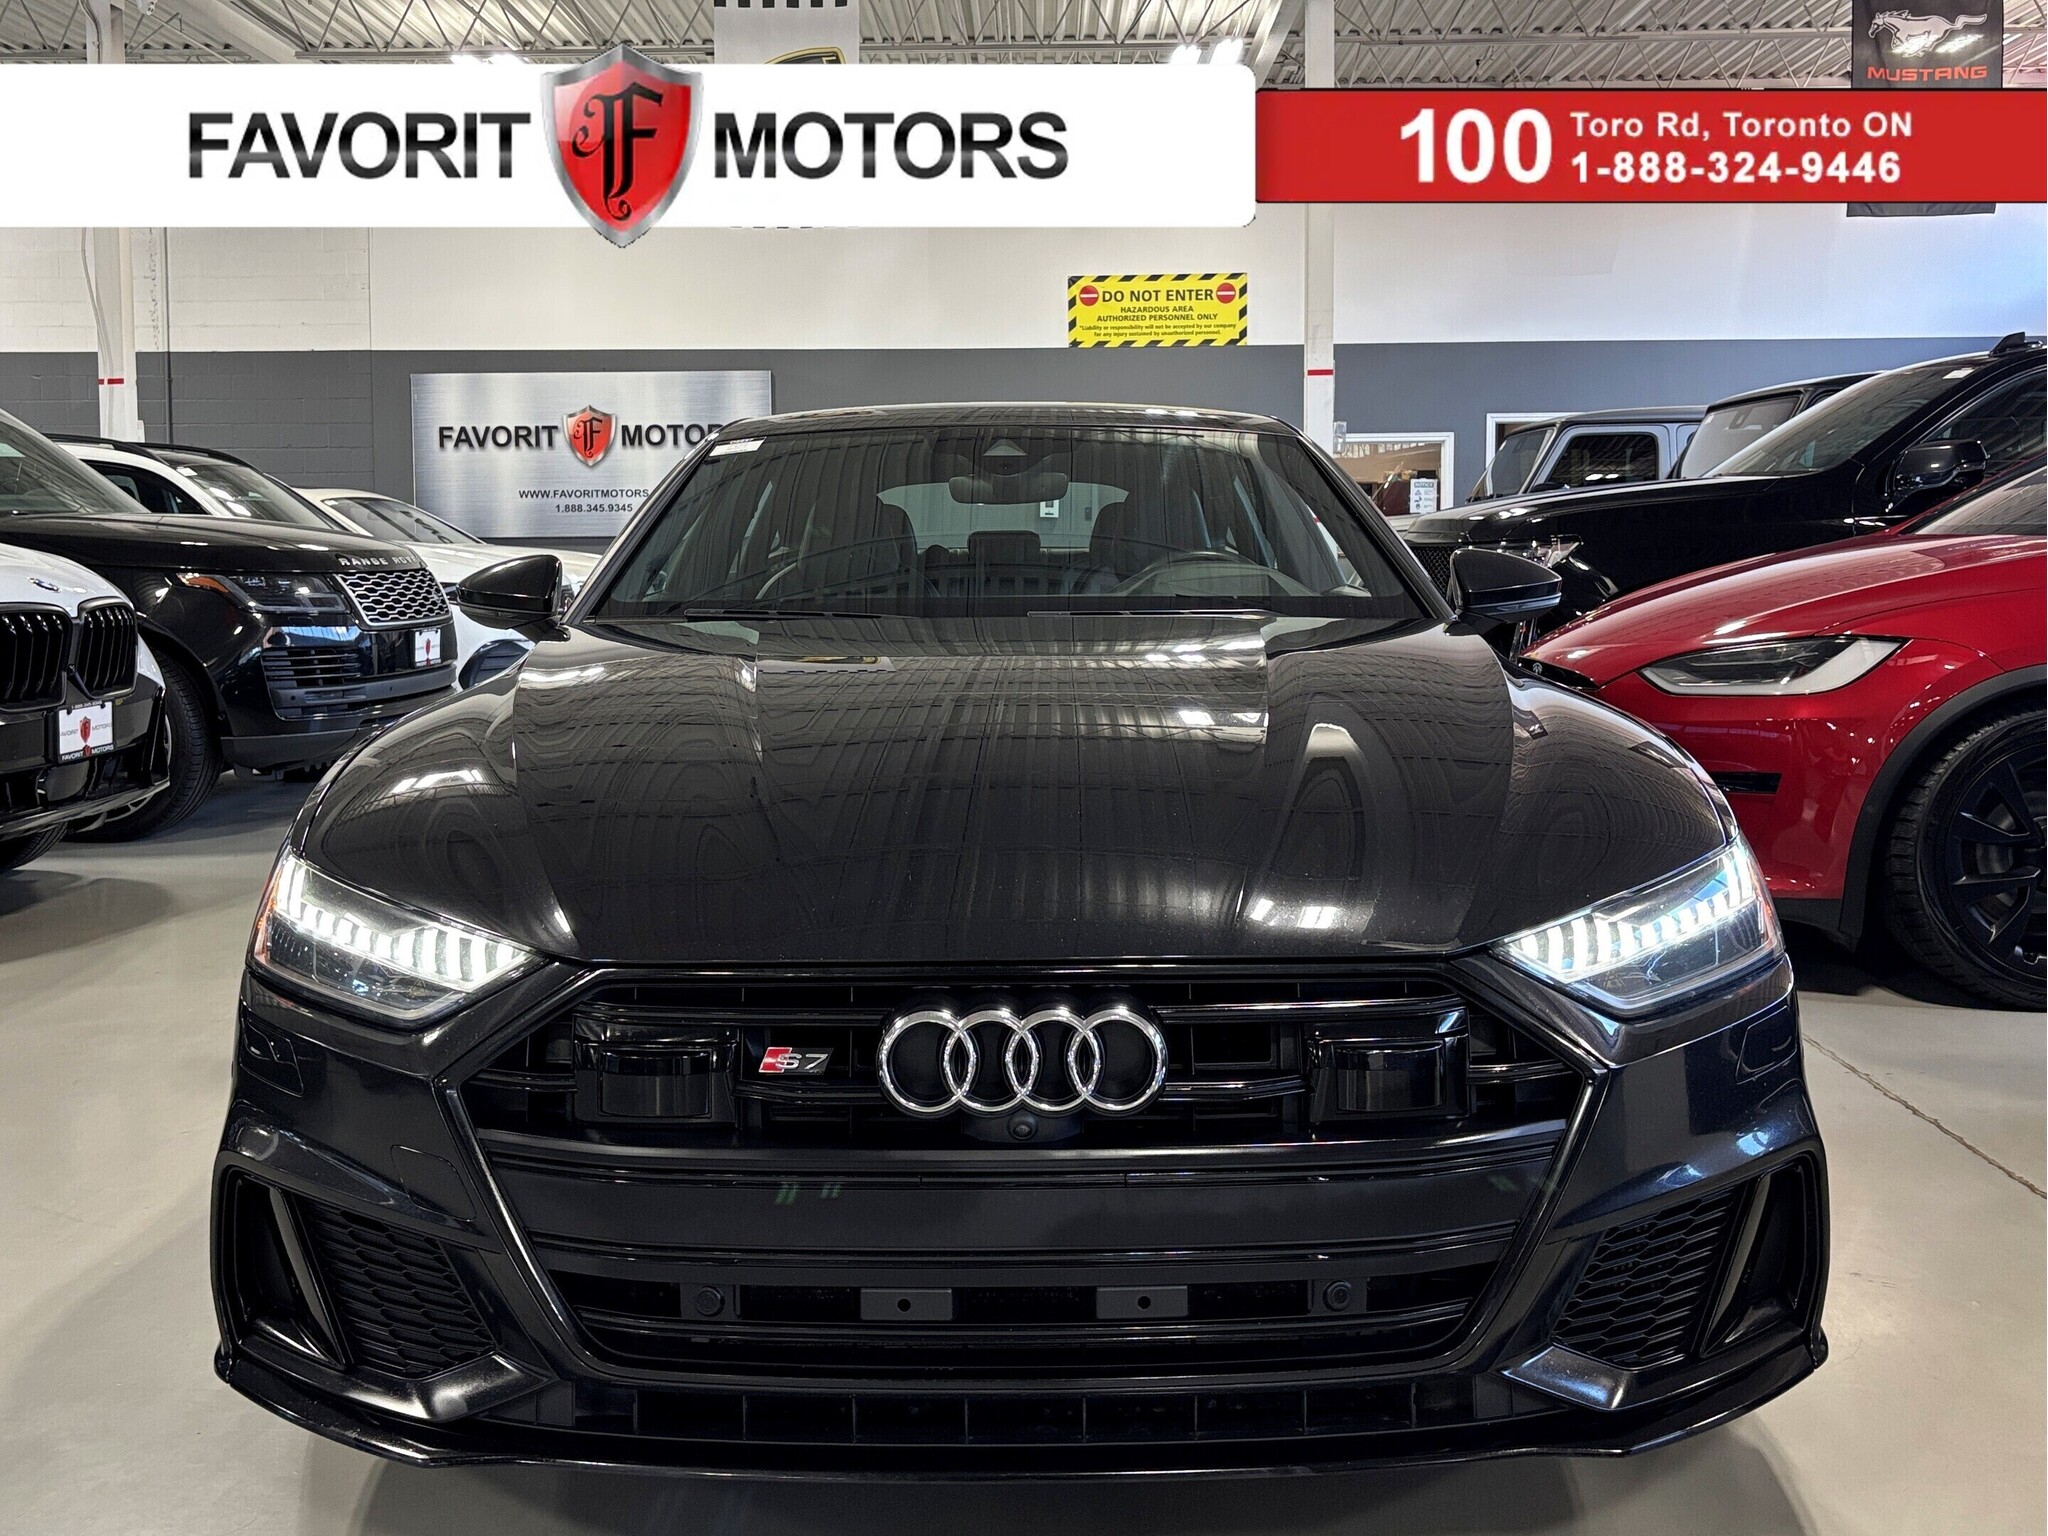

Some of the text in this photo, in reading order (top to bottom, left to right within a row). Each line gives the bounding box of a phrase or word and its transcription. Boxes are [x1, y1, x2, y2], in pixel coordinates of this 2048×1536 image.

[1867, 66, 1988, 81] MUSTANG
[1102, 289, 1214, 303] DO NOT ENTER
[438, 425, 558, 448] FAVORIT
[555, 504, 633, 513] 1.888.345.9345
[339, 558, 388, 566] RANGE
[775, 1053, 828, 1070] S7
